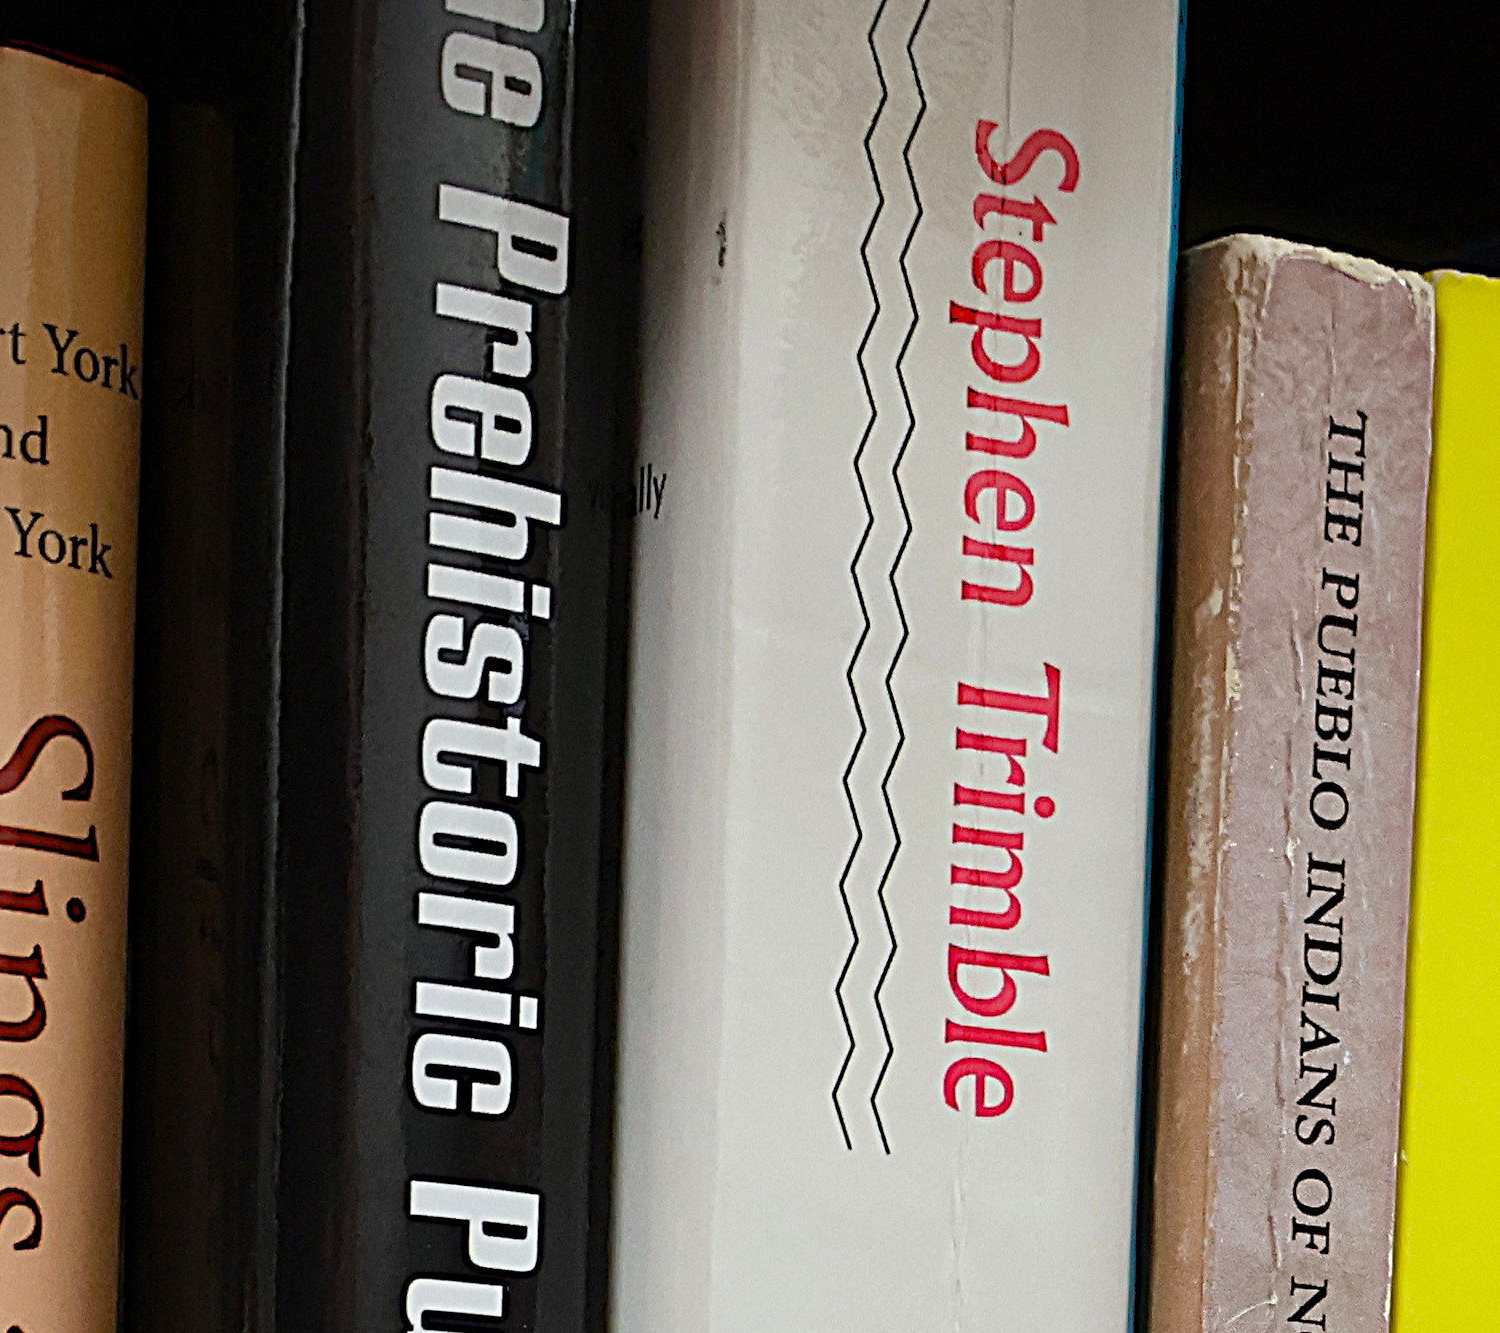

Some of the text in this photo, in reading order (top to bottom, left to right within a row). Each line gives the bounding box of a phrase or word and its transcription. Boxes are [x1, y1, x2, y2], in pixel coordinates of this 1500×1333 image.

[41, 324, 140, 400] York
[4, 507, 113, 579] York
[1322, 411, 1369, 548] THE
[411, 184, 573, 1115] Prehistoric
[943, 118, 1082, 1120] Stephen Trimble
[1308, 567, 1360, 833] PUEBLO
[1293, 852, 1346, 1148] INDIANS
[1291, 1167, 1333, 1255] OF
